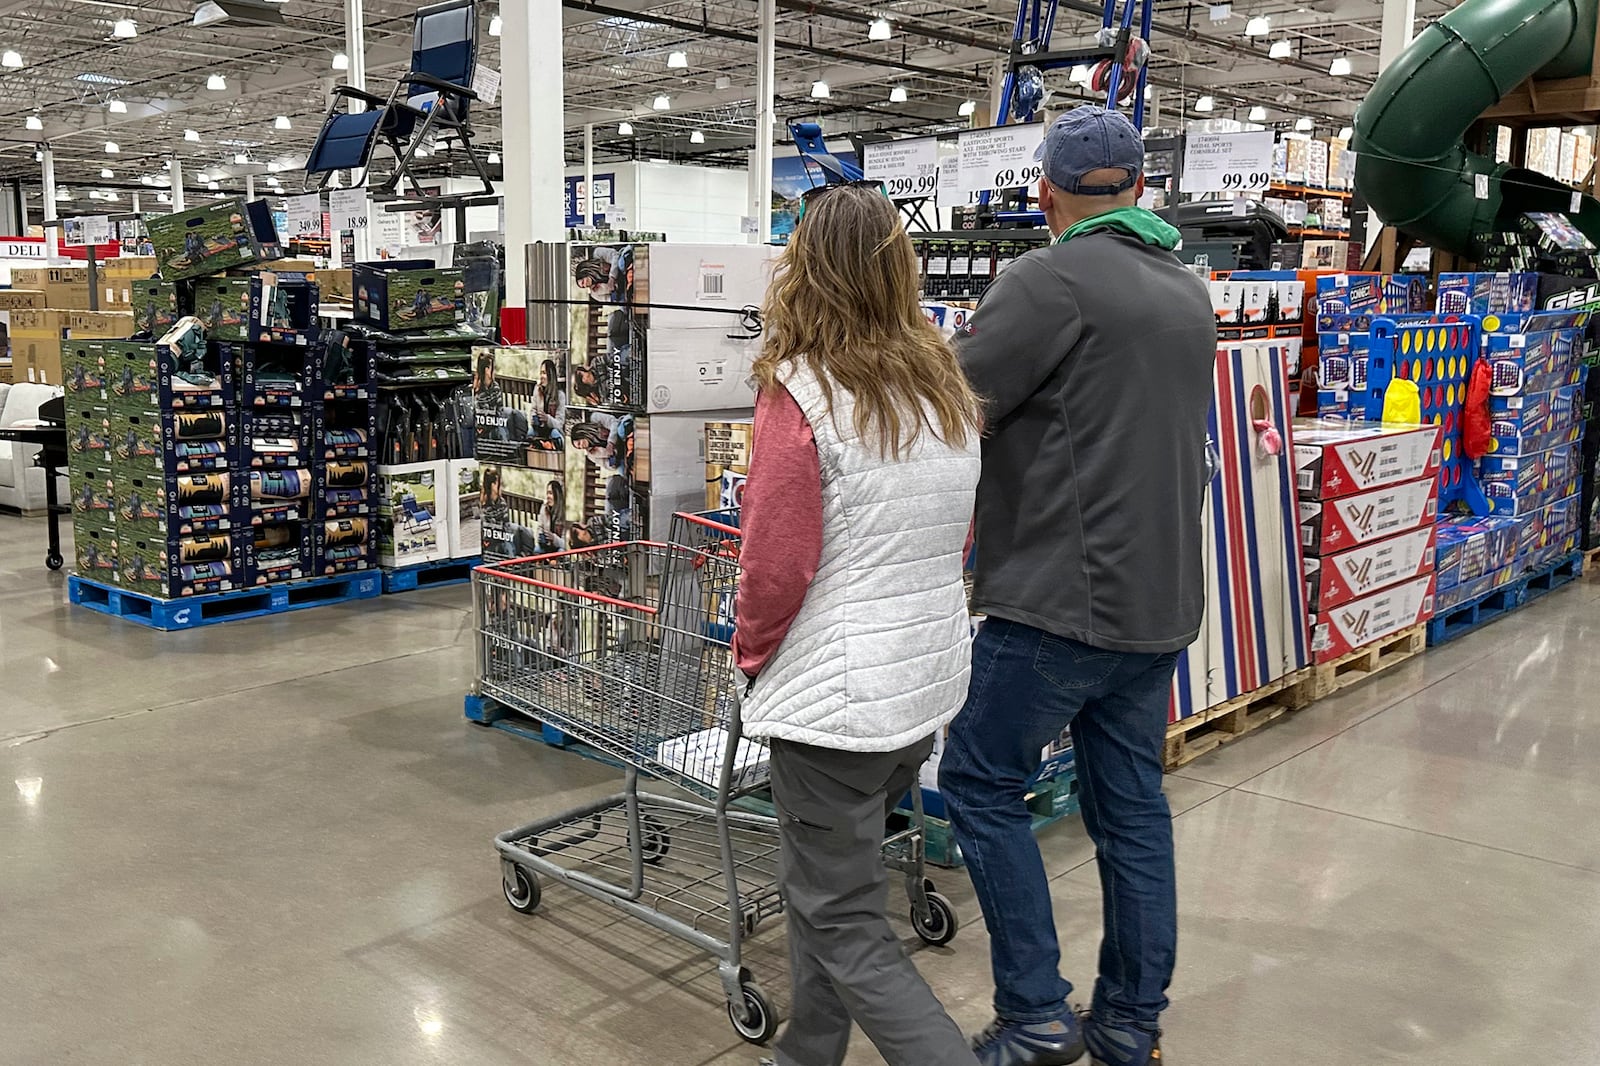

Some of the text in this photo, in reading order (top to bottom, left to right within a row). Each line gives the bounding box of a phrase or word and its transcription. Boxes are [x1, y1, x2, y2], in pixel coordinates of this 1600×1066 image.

[993, 135, 1014, 143] SPORTS
[975, 143, 995, 152] THROW
[978, 148, 1008, 157] THROWING
[995, 166, 1041, 187] 69.99
[1222, 172, 1270, 190] 99.99
[888, 175, 935, 195] 299.99
[298, 219, 320, 232] 349.99
[347, 216, 368, 229] 18.99
[8, 245, 41, 256] DELI
[1547, 286, 1600, 311] GEL
[613, 347, 622, 403] TO ENJOY
[475, 415, 508, 427] TO ENJOY
[612, 509, 620, 540] NJOY
[483, 528, 515, 542] TO ENJOY
